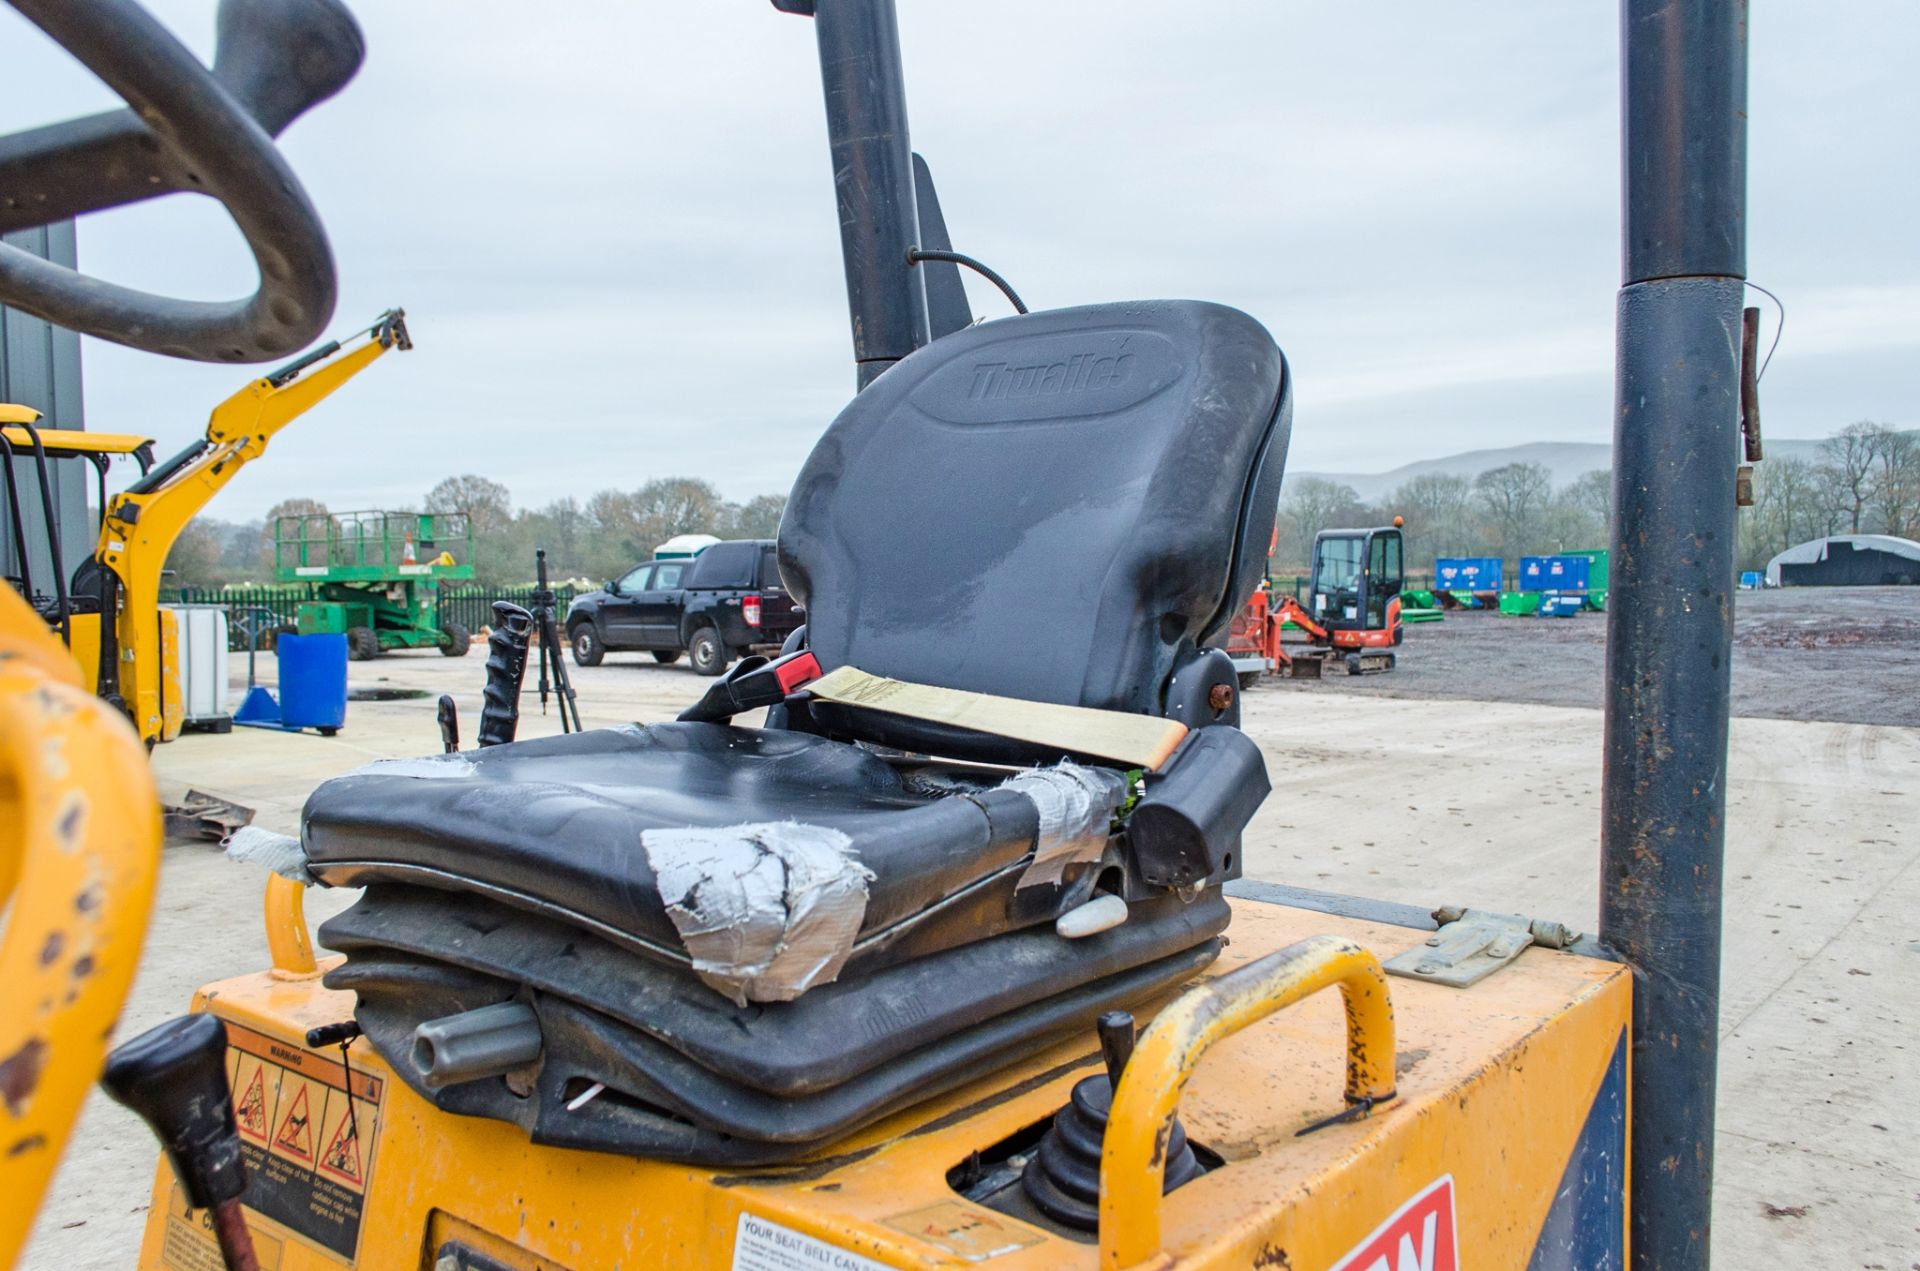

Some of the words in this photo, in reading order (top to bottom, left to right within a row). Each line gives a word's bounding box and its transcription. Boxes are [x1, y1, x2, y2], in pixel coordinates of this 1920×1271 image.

[270, 1046, 302, 1066] WARNING
[744, 1219, 773, 1241] YOUR
[775, 1232, 802, 1252] SEAT
[804, 1244, 831, 1263] BELT
